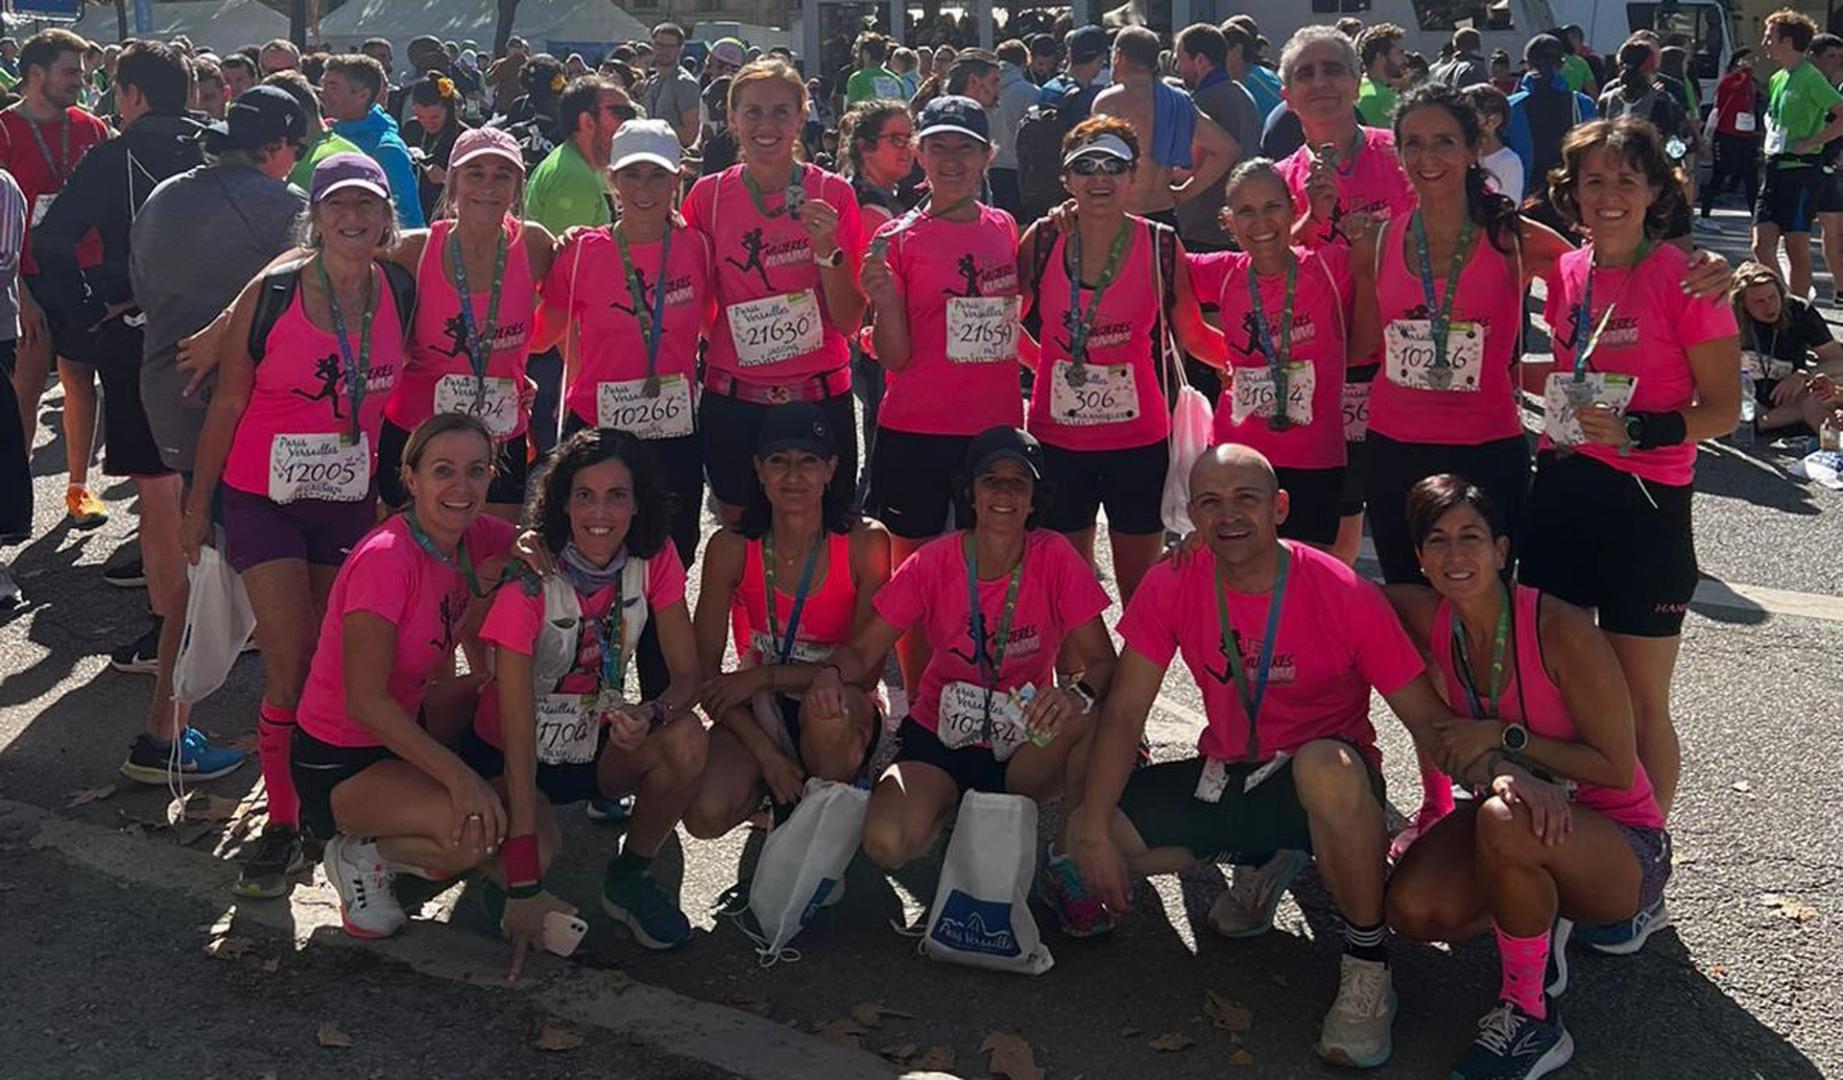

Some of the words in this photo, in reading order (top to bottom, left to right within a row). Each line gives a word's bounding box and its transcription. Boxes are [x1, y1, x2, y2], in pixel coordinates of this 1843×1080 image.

[746, 317, 809, 346] 21630
[960, 321, 1012, 347] 21659
[1400, 346, 1467, 370] 1026
[1073, 389, 1115, 412] 306
[1241, 386, 1303, 407] 2164
[611, 396, 680, 426] 10266
[284, 461, 356, 486] 12005
